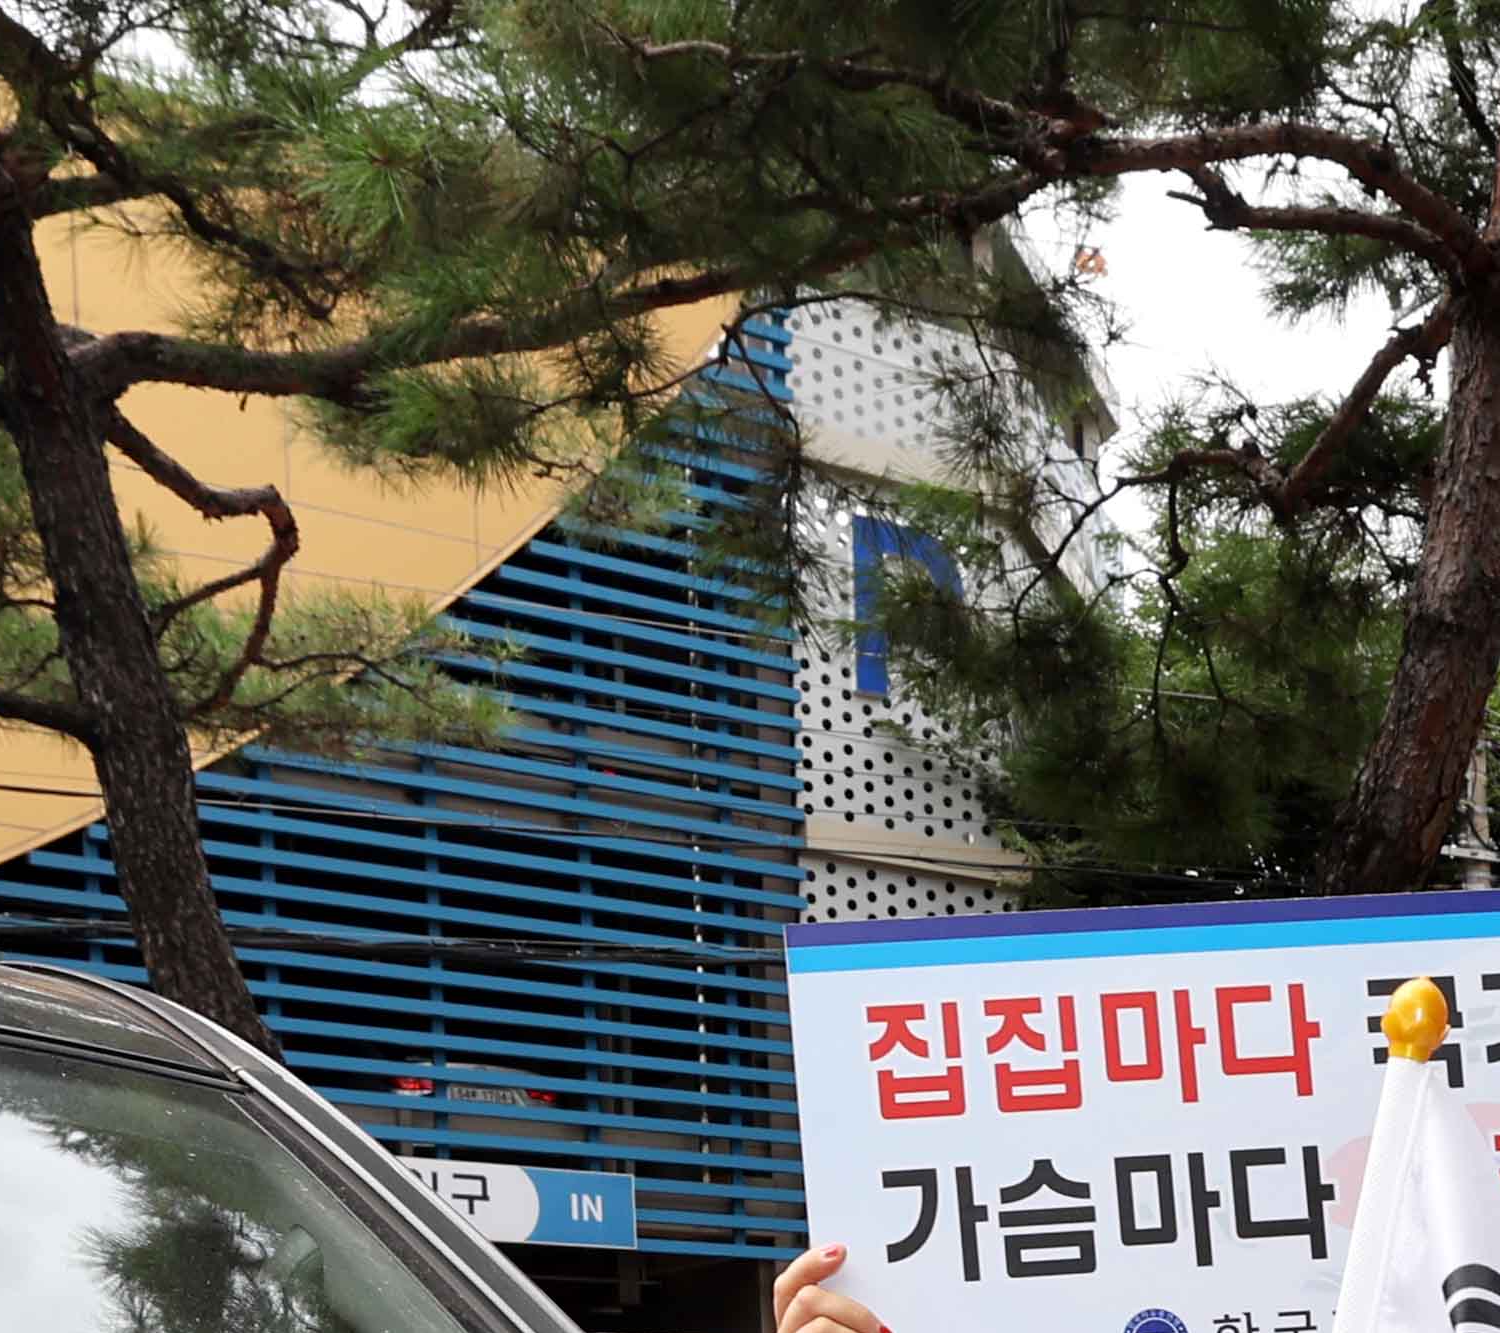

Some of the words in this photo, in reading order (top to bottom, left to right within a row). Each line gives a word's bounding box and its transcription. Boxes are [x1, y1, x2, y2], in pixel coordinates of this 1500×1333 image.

[865, 982, 1321, 1121] 집집마다
[570, 1193, 604, 1223] IN
[881, 1131, 1334, 1282] 가슴마다
